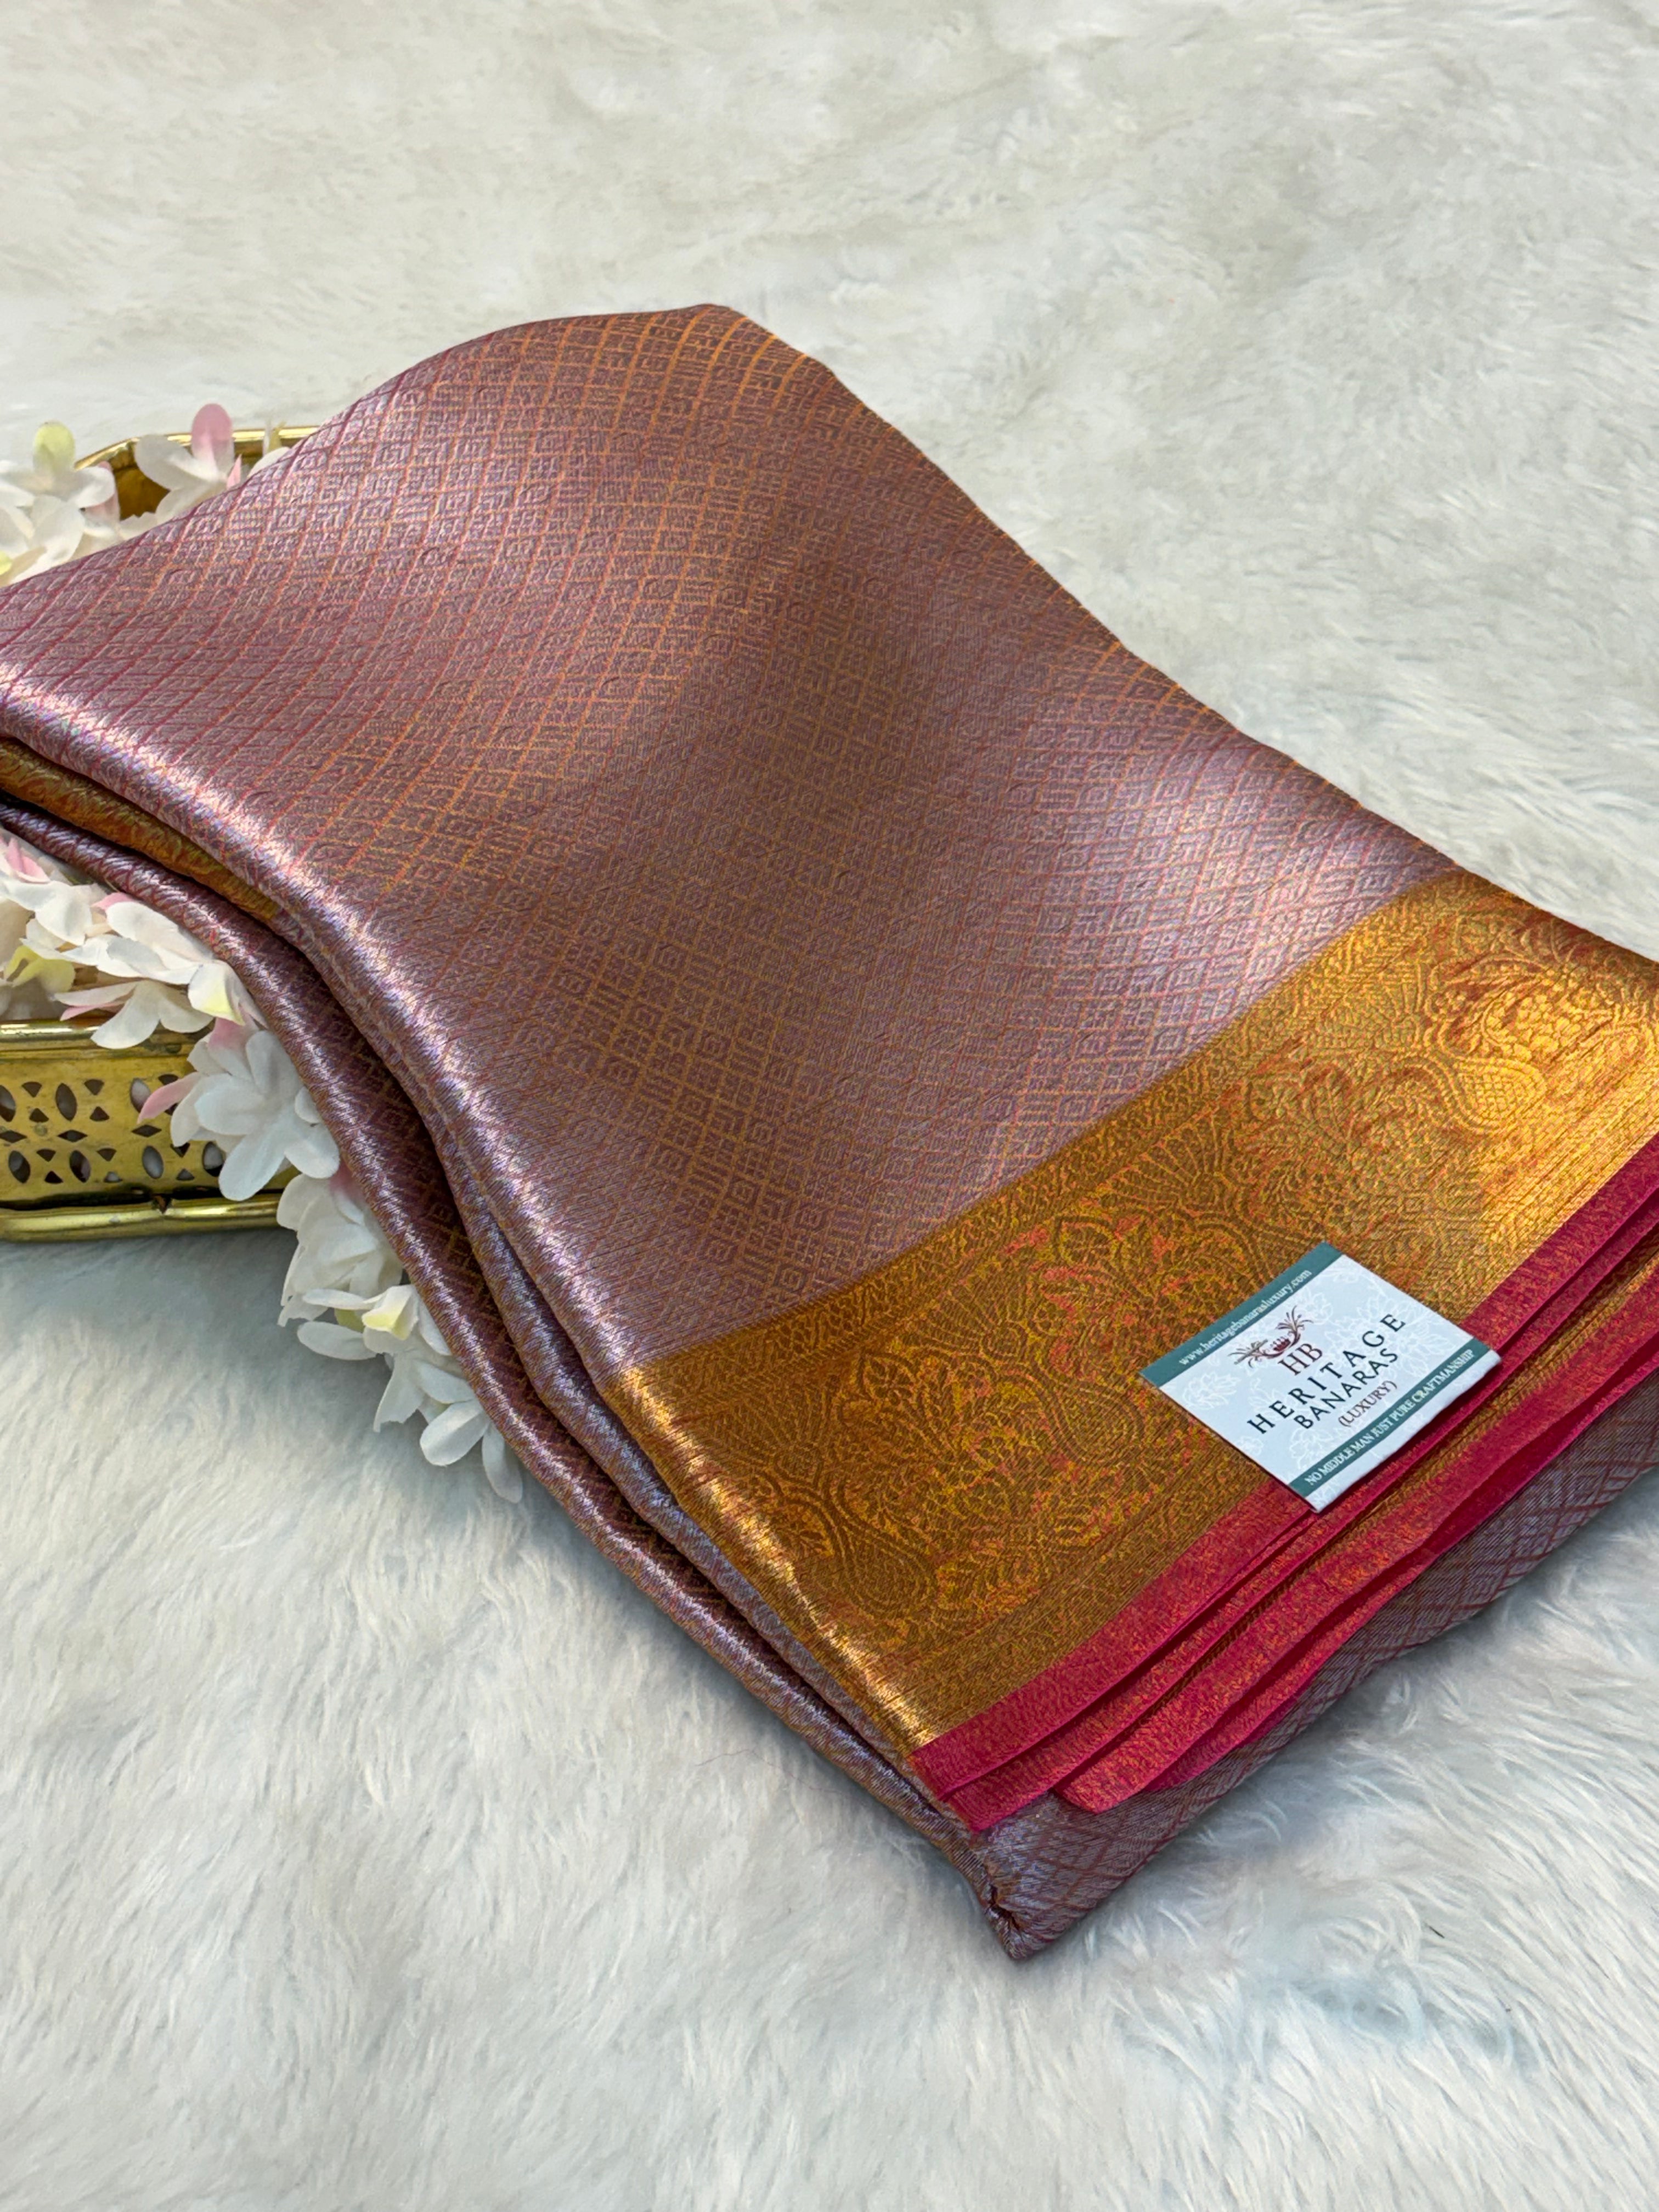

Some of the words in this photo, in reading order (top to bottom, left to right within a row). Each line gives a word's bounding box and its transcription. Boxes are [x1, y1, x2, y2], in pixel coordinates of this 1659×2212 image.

[1180, 1270, 1312, 1365] www.heritagebanarasluxury.com
[1279, 1342, 1323, 1374] HB
[1247, 1314, 1405, 1434] HERITAGE
[1294, 1348, 1398, 1429] BANARAS
[1305, 1471, 1321, 1486] NO
[1318, 1446, 1355, 1476] MIDDLE
[1351, 1432, 1376, 1453] MAN
[1373, 1417, 1393, 1438] JUST
[1392, 1397, 1416, 1421] PURE
[1412, 1349, 1475, 1403] CRAFTMANSHIP
[1338, 1380, 1397, 1427] (LUXURY)
